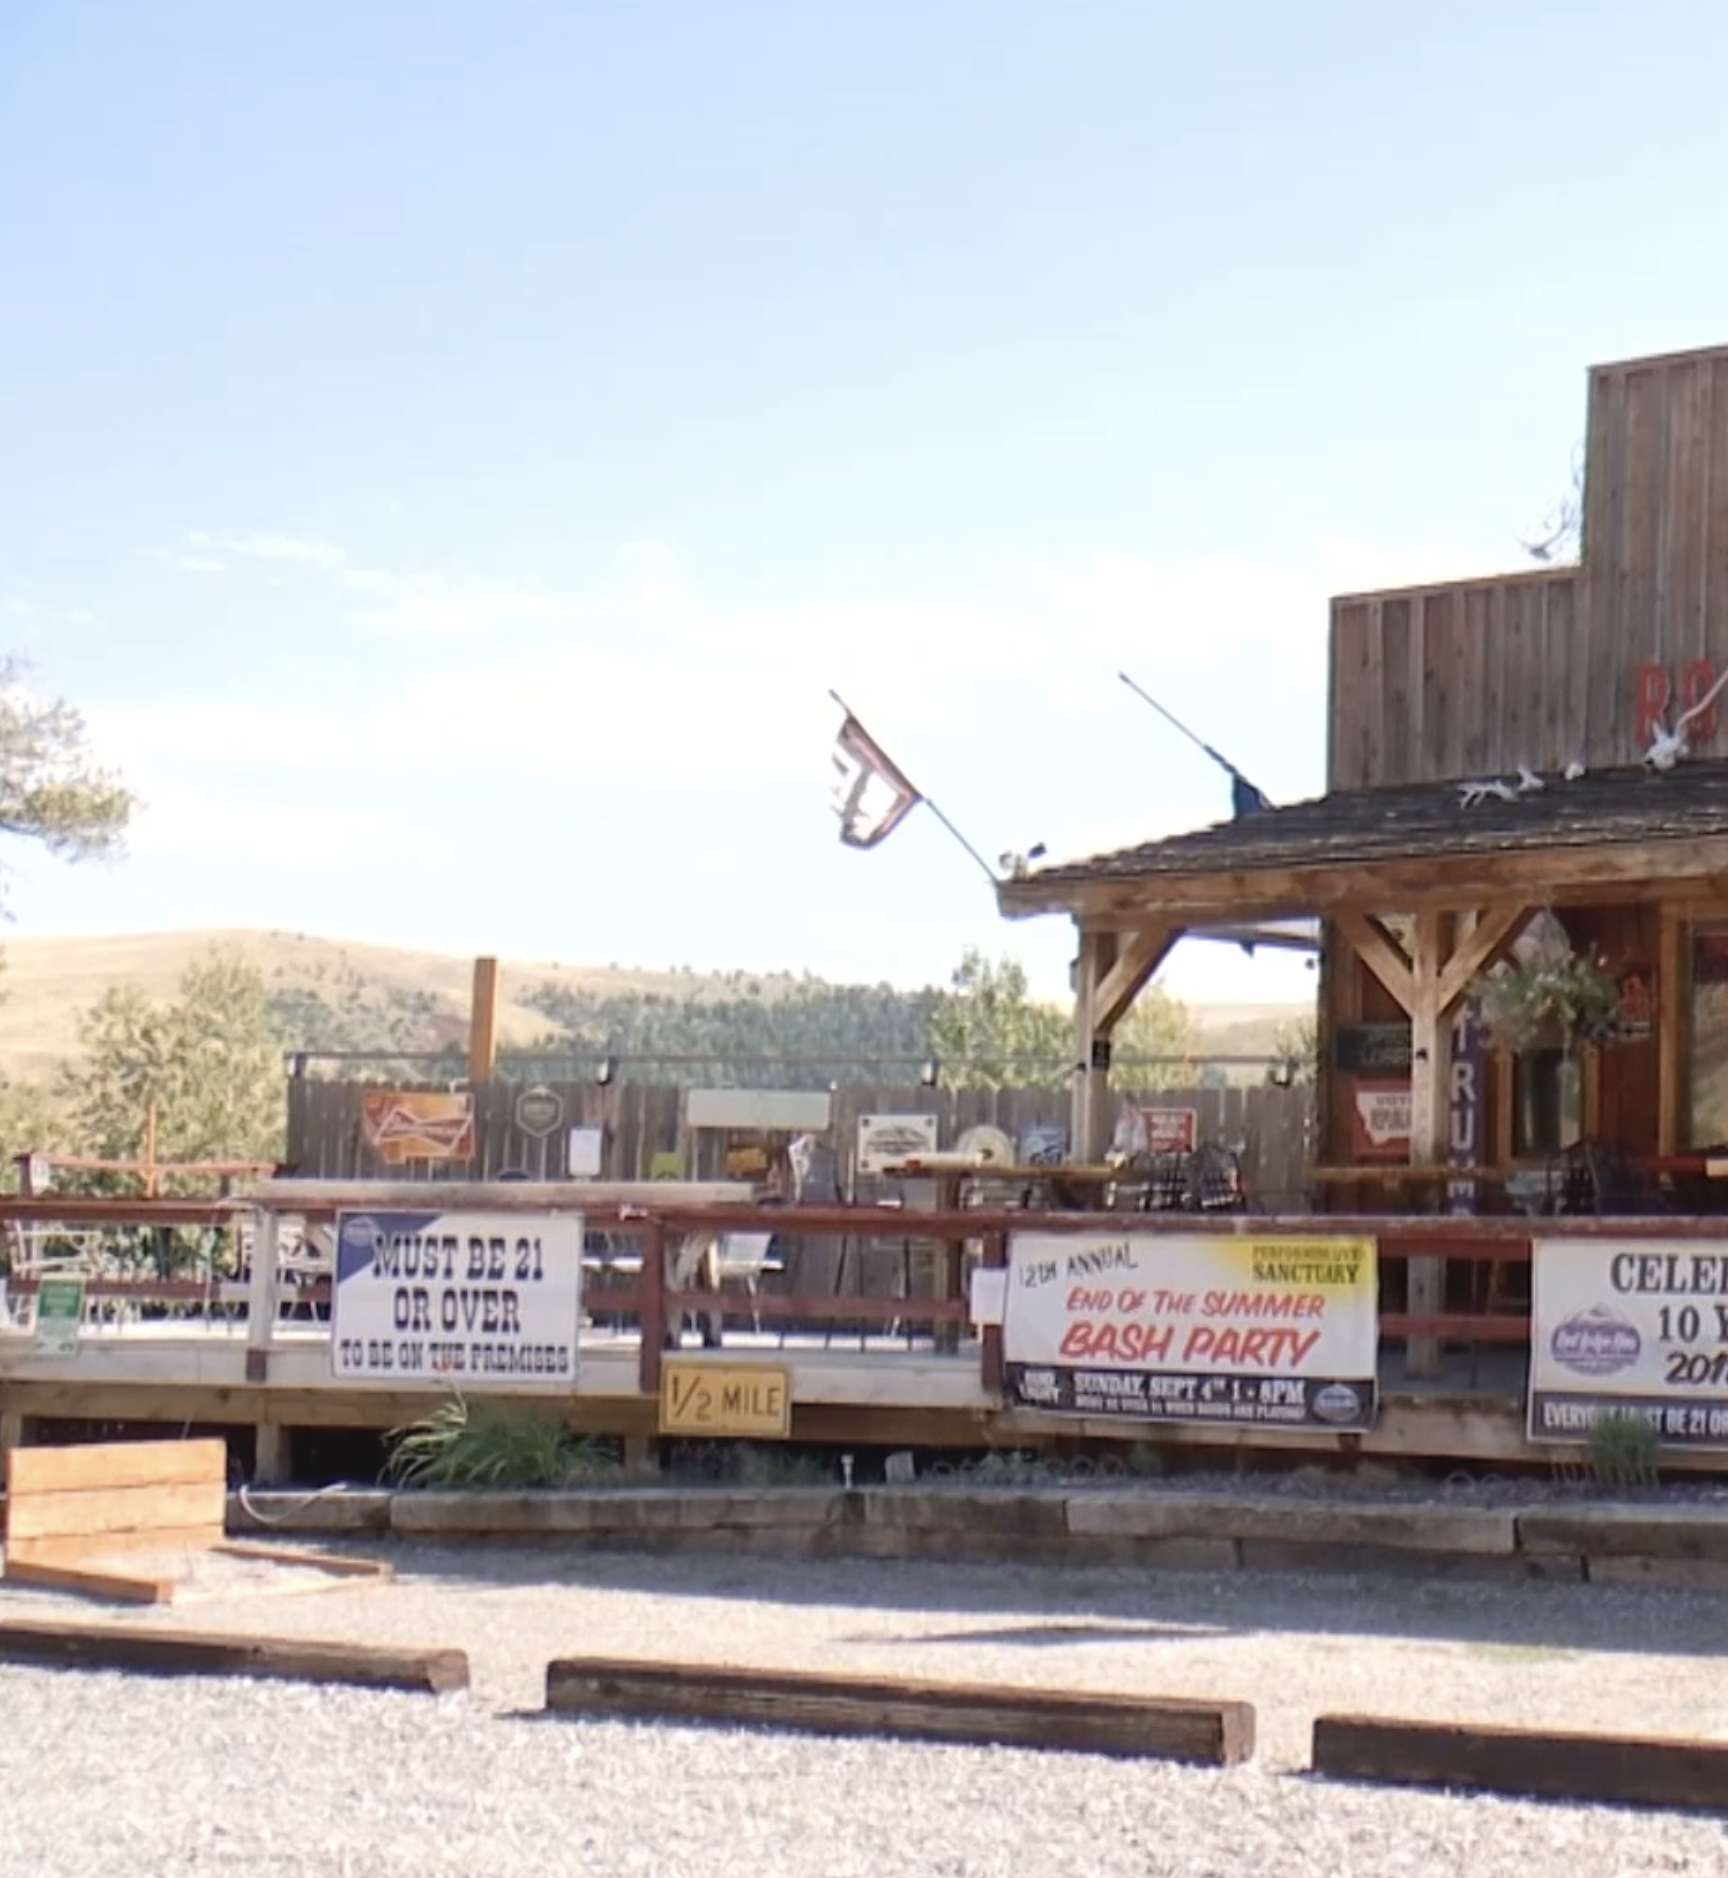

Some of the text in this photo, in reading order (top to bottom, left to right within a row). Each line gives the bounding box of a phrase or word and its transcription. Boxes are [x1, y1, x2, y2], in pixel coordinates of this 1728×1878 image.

[1448, 1003, 1477, 1216] TRUM
[372, 1233, 544, 1282] MUST BE 21
[1066, 1240, 1139, 1278] ANNUAL
[1251, 1260, 1360, 1285] SANCTUARY
[393, 1286, 521, 1334] OR OVER
[1066, 1285, 1326, 1319] END OF THE SUMMER
[1059, 1318, 1322, 1368] BASH PARTY
[1657, 1304, 1700, 1343] 10
[340, 1338, 569, 1374] TO BE ON THE PREMISES
[671, 1374, 782, 1422] 1/2 MILE
[1665, 1406, 1688, 1435] BE
[1689, 1408, 1707, 1435] 21
